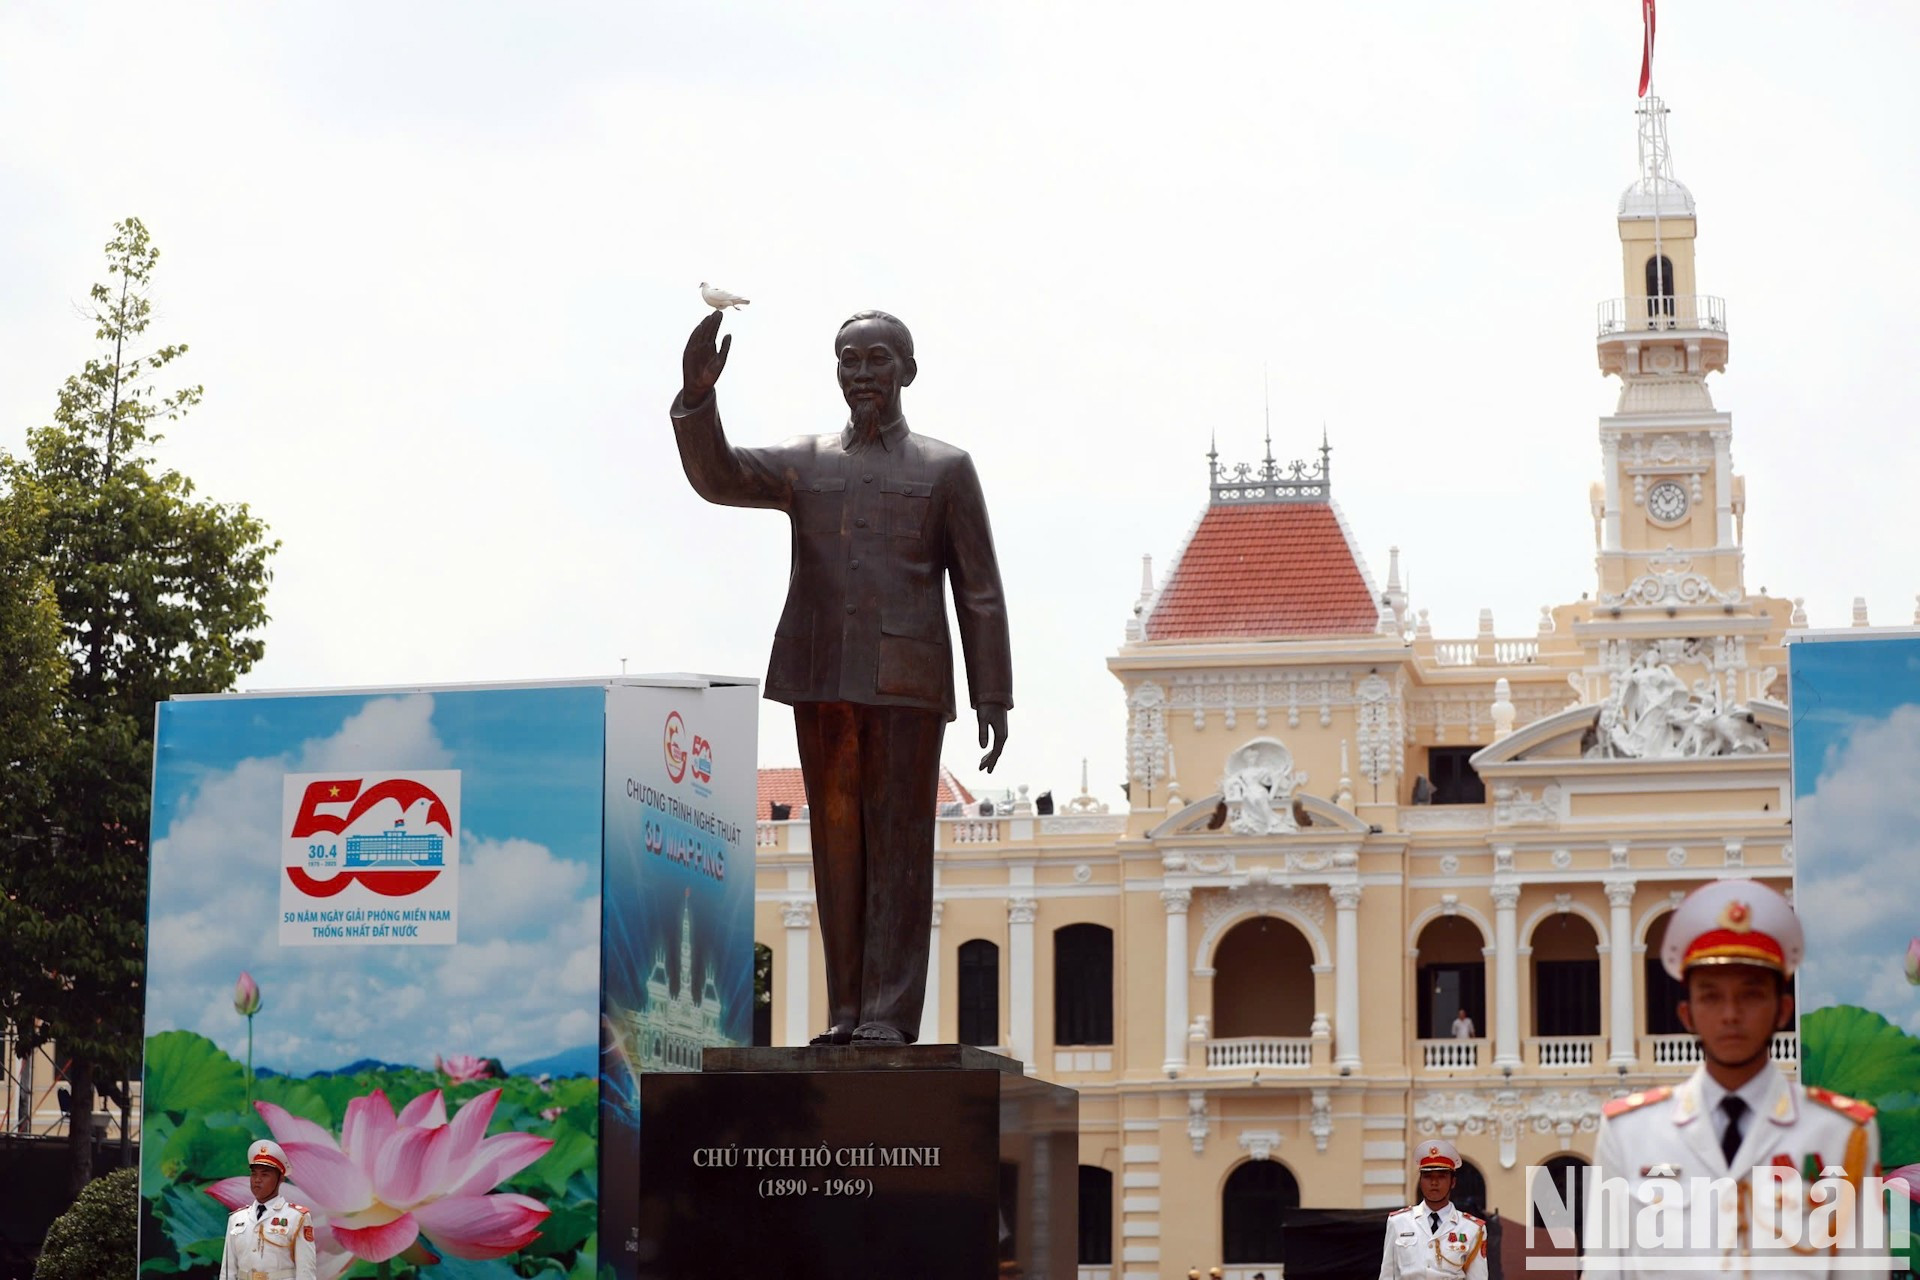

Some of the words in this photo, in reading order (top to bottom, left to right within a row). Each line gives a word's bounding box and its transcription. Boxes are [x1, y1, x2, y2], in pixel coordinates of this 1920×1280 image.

[626, 777, 666, 812] CHƯƠNG
[668, 796, 692, 825] TRÌNH
[693, 809, 716, 839] NGHỆ
[717, 819, 742, 849] THUẬT
[286, 778, 453, 898] 50
[645, 819, 663, 856] 3D
[666, 829, 725, 881] MAPPING
[308, 844, 338, 859] 30.4
[283, 912, 296, 923] 50
[320, 909, 344, 922] NGÀY
[345, 907, 365, 922] GIẢI
[367, 908, 400, 921] PHÓNG
[429, 909, 451, 921] NAM
[312, 924, 344, 938] THỐNG
[345, 923, 371, 937] NHẤT
[372, 923, 391, 937] ĐẤT
[392, 923, 418, 937] NƯỚC
[692, 1143, 739, 1168] CHỦ
[743, 1147, 796, 1171] TỊCH
[799, 1139, 832, 1168] HỒ
[835, 1142, 875, 1168] CHÍ
[879, 1147, 941, 1168] MINH
[758, 1178, 808, 1199] (1890
[823, 1178, 874, 1199] 1969)
